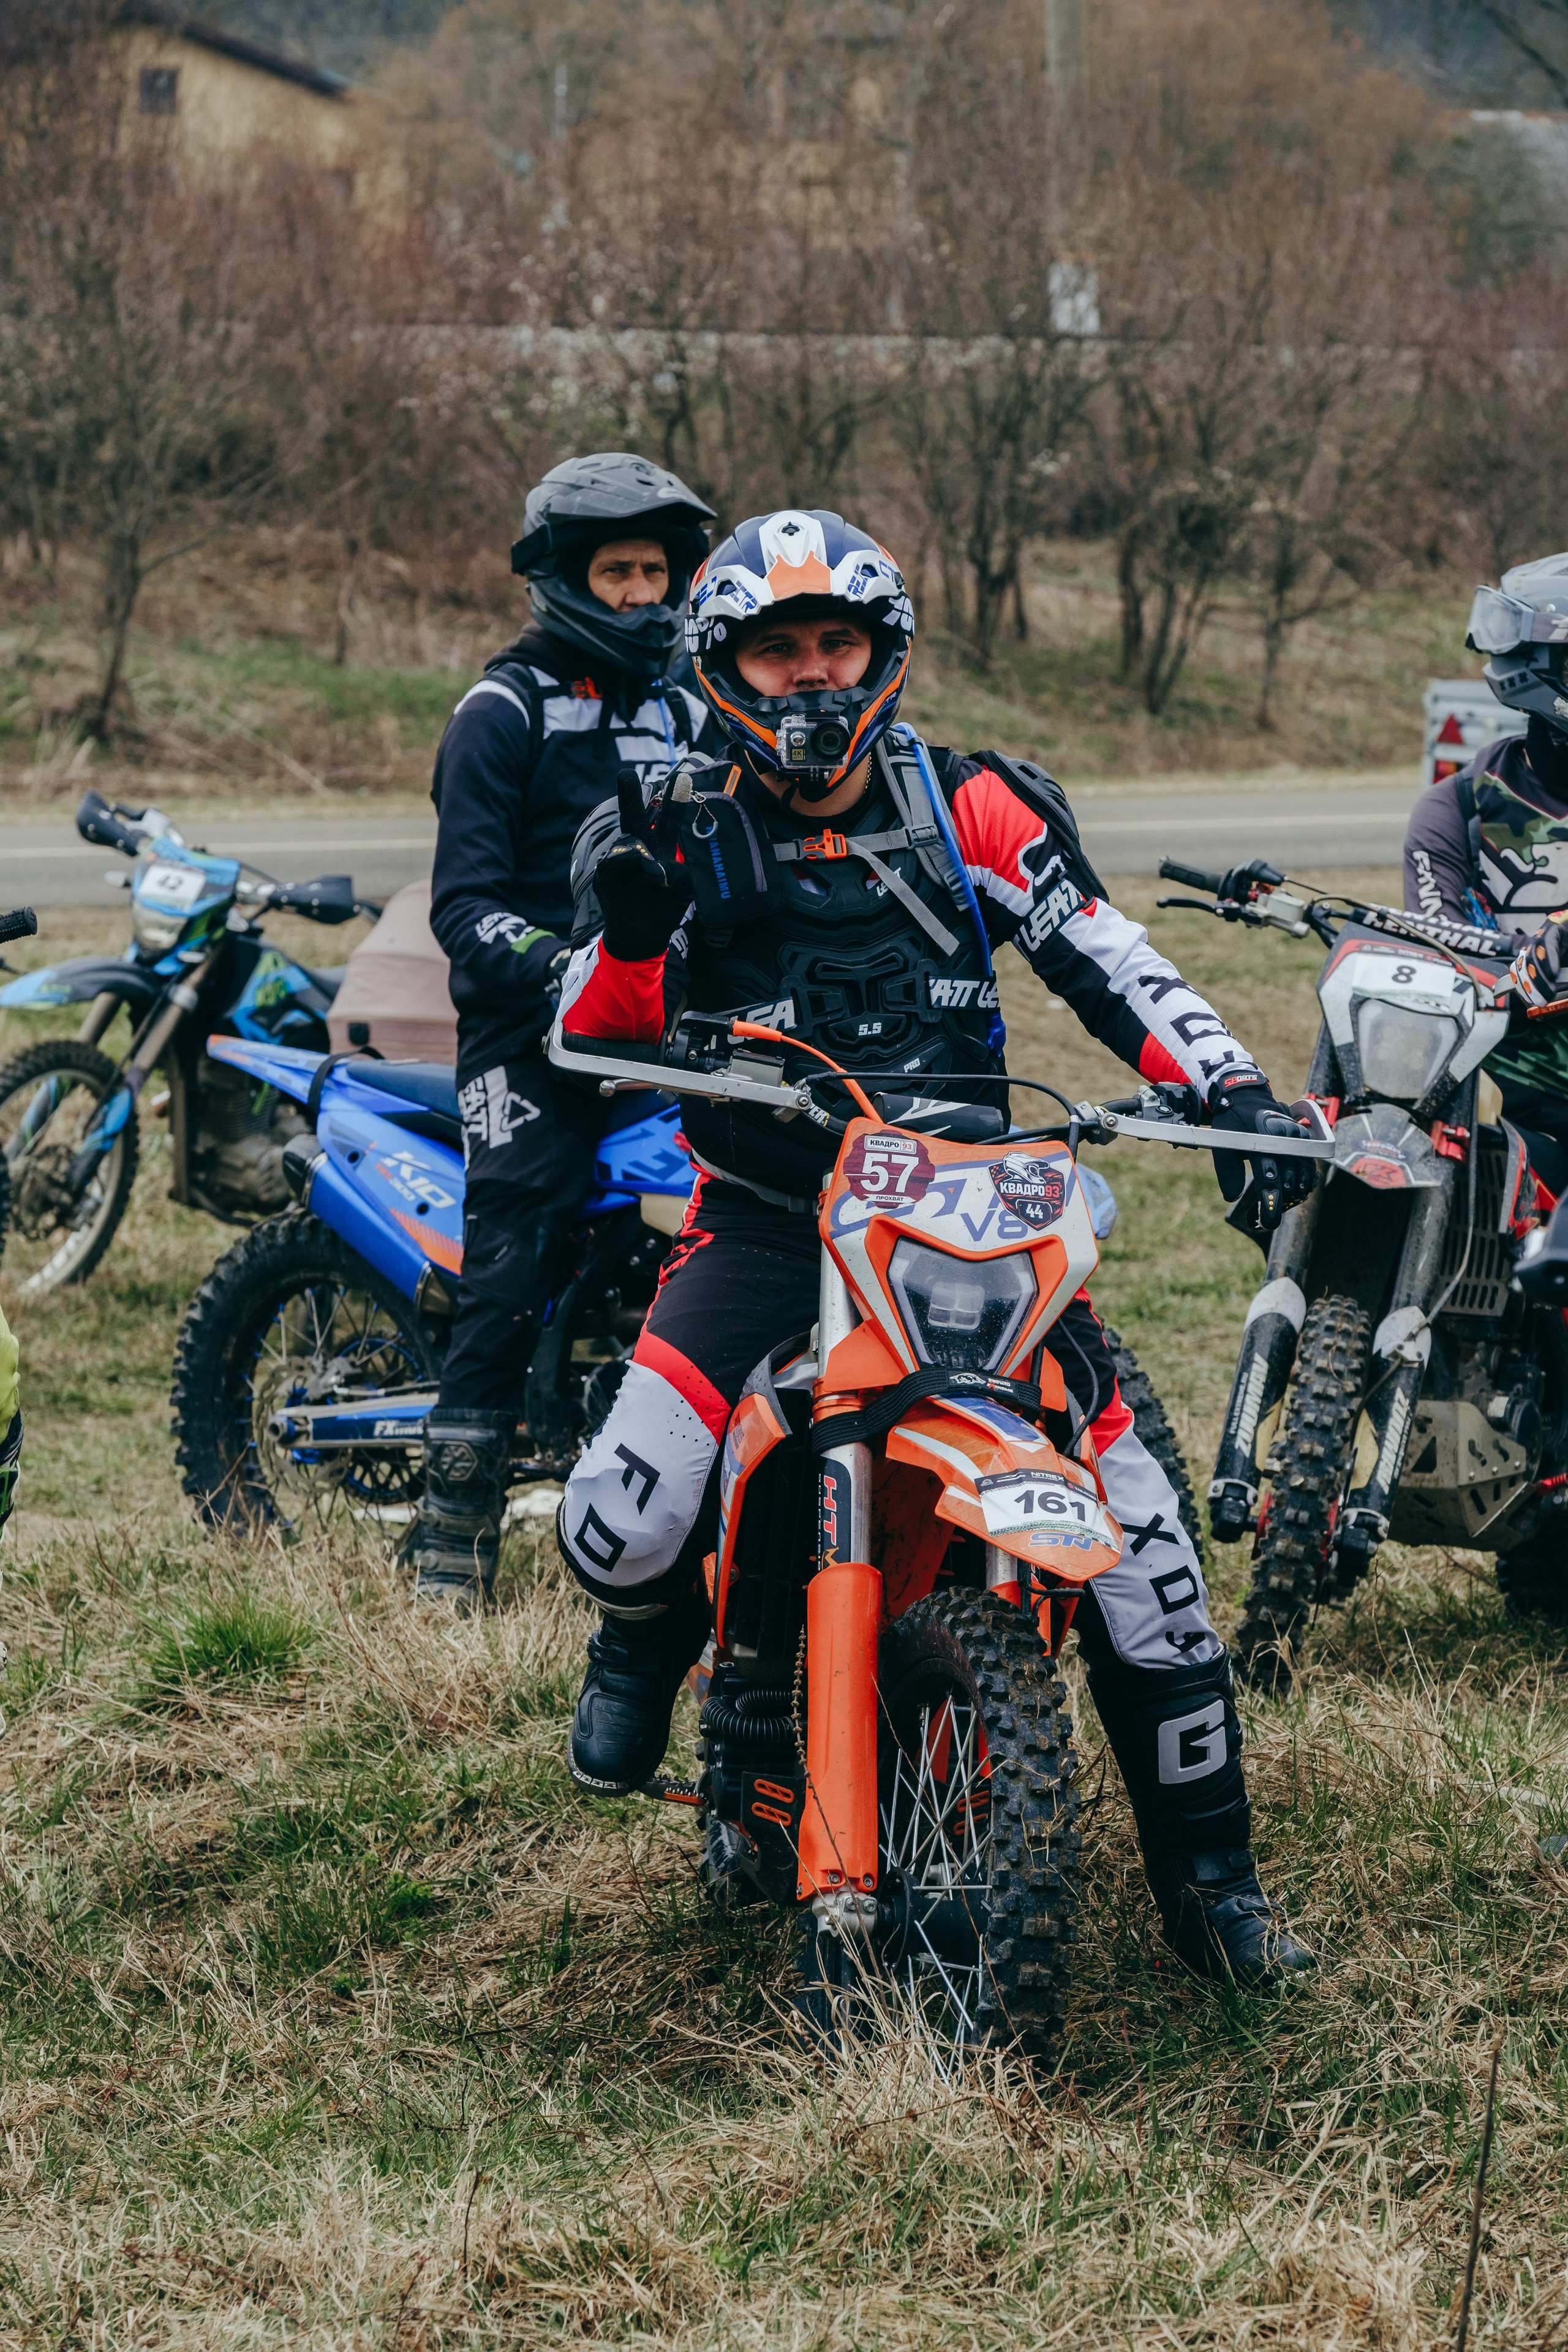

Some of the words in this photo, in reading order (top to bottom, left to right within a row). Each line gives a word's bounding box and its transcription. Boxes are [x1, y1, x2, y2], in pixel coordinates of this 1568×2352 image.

[1392, 965, 1417, 984] 8
[858, 1022, 882, 1036] 5.5
[903, 1057, 921, 1073] PRO
[1224, 1074, 1259, 1088] SPORTS
[870, 1139, 900, 1148] КВАДРО
[860, 1152, 919, 1193] 57
[1025, 1203, 1044, 1219] 44
[960, 1209, 1028, 1242] V8
[1031, 1471, 1065, 1482] NITREX
[1014, 1490, 1086, 1523] 161
[1158, 1699, 1227, 1785] G
